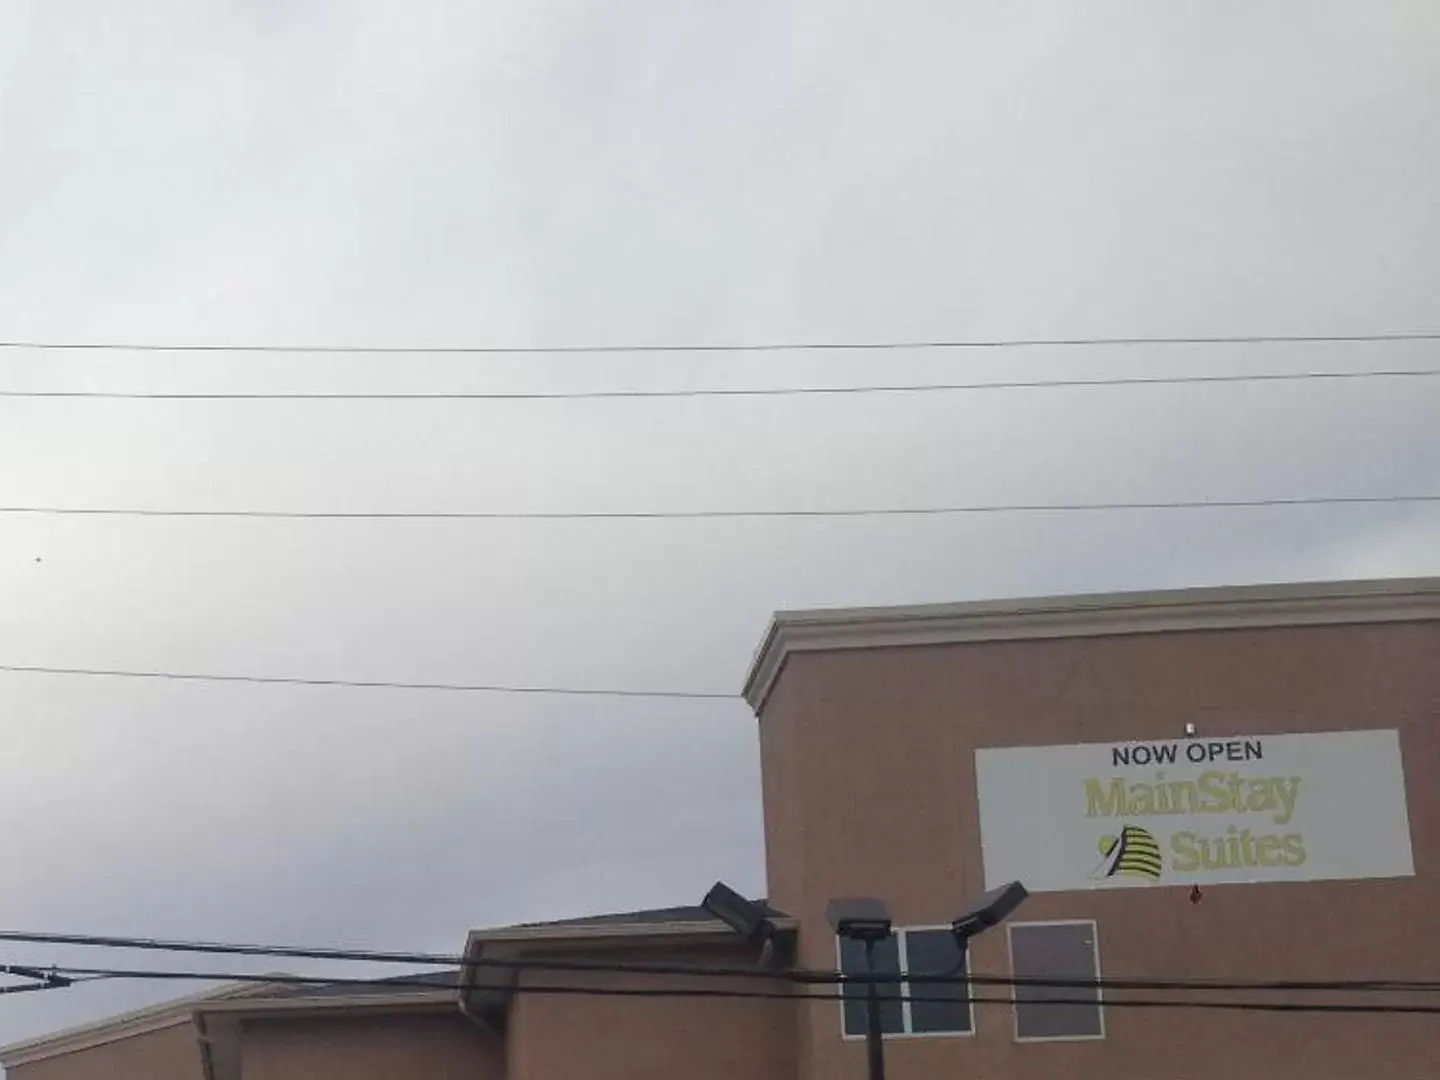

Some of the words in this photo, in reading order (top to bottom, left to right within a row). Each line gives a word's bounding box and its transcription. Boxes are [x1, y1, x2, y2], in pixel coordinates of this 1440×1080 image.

[1112, 744, 1177, 766] NOW
[1186, 741, 1263, 763] OPEN
[1084, 771, 1302, 825] MainStay
[1170, 824, 1306, 871] Suites
